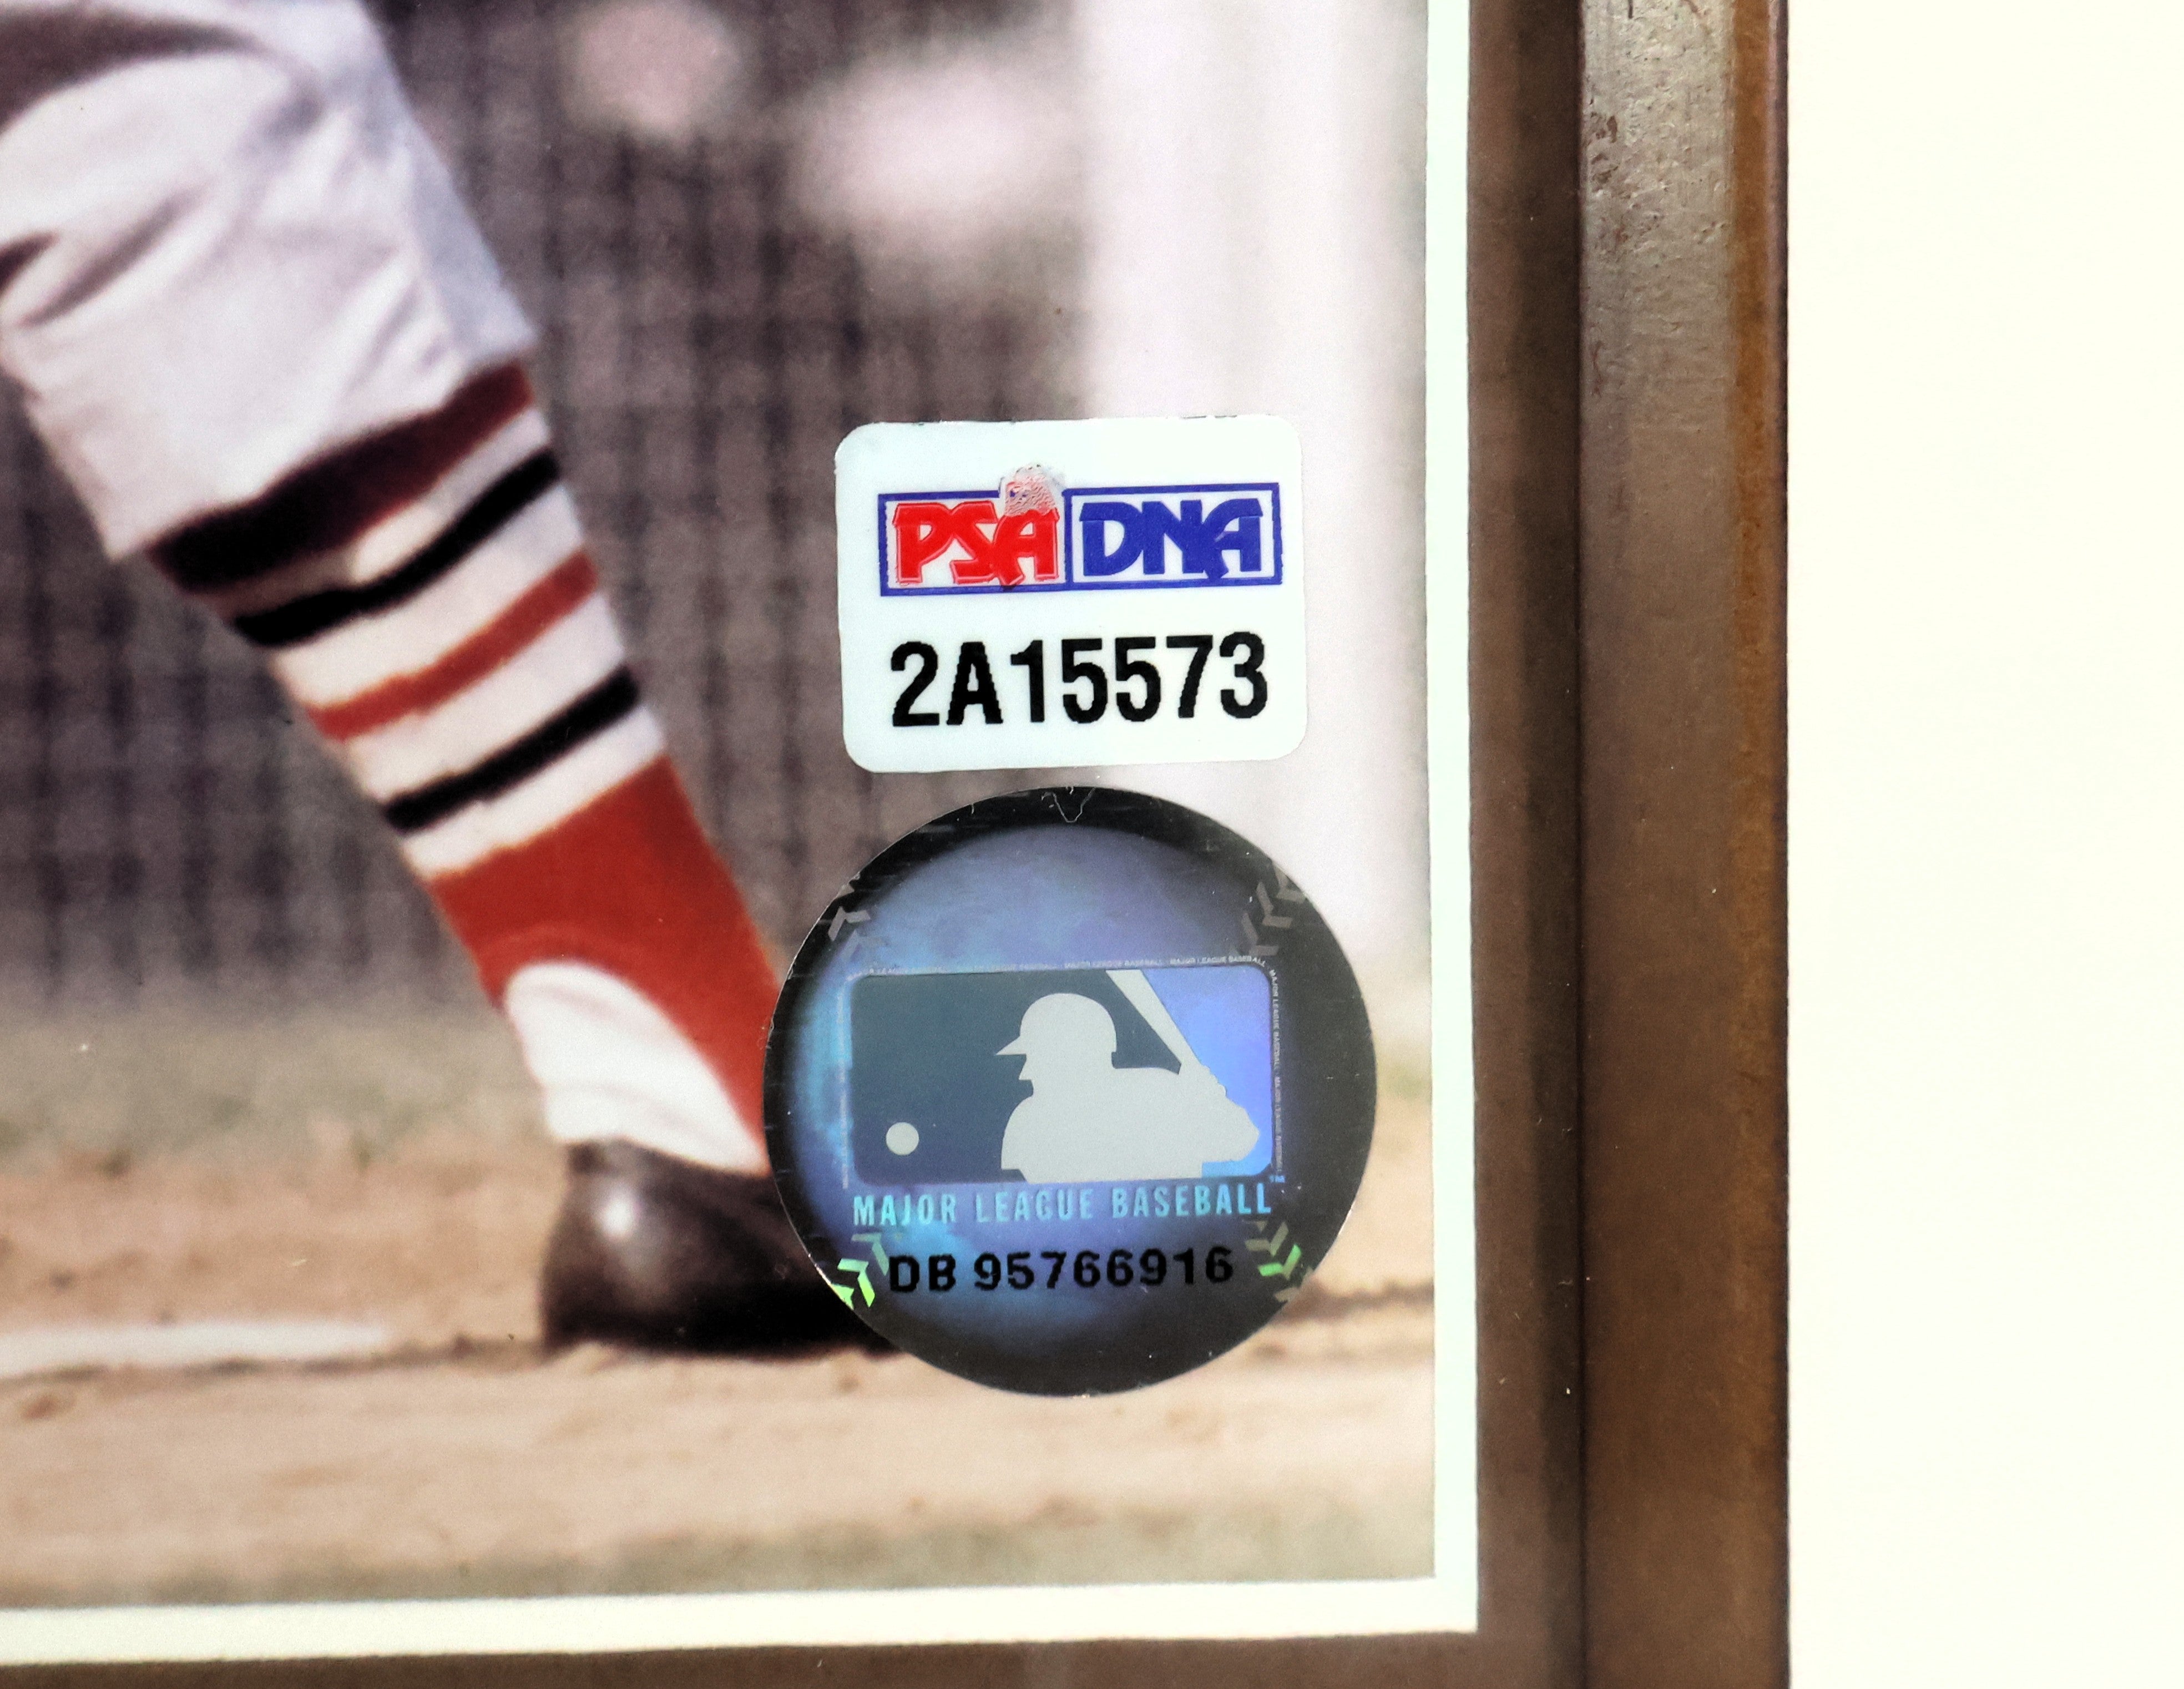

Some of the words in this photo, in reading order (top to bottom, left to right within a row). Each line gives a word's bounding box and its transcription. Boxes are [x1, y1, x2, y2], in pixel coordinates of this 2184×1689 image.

[894, 500, 1060, 588] PSA
[1080, 498, 1263, 580] DNA
[890, 631, 1268, 728] 2A15573
[853, 1194, 957, 1226] MAJOR
[975, 1187, 1095, 1222] LEAGUE
[1111, 1183, 1272, 1218] BASEBALL
[889, 1253, 957, 1293] DB
[974, 1246, 1235, 1290] 95766916
